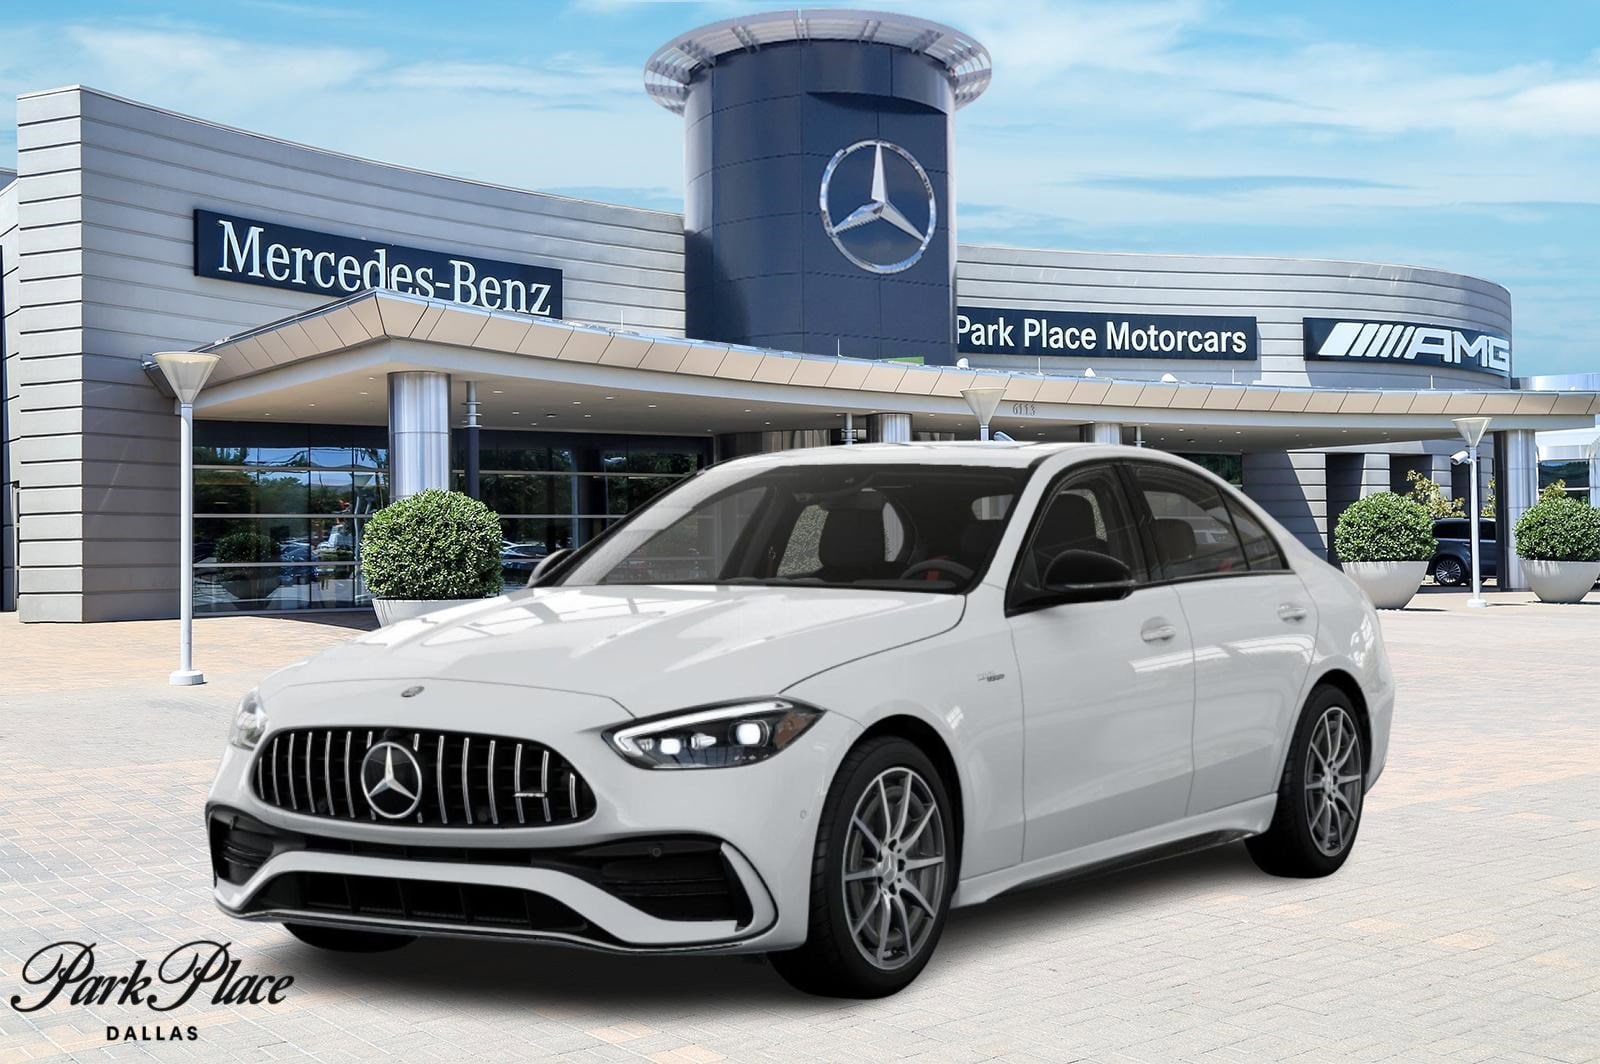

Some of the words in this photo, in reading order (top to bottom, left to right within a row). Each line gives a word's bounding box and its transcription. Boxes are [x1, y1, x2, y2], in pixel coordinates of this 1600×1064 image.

[218, 220, 552, 316] Mercedes-Benz
[957, 315, 1015, 347] Park
[1023, 318, 1097, 350] Place
[1106, 321, 1248, 354] Motorcars
[1012, 403, 1036, 416] 6113
